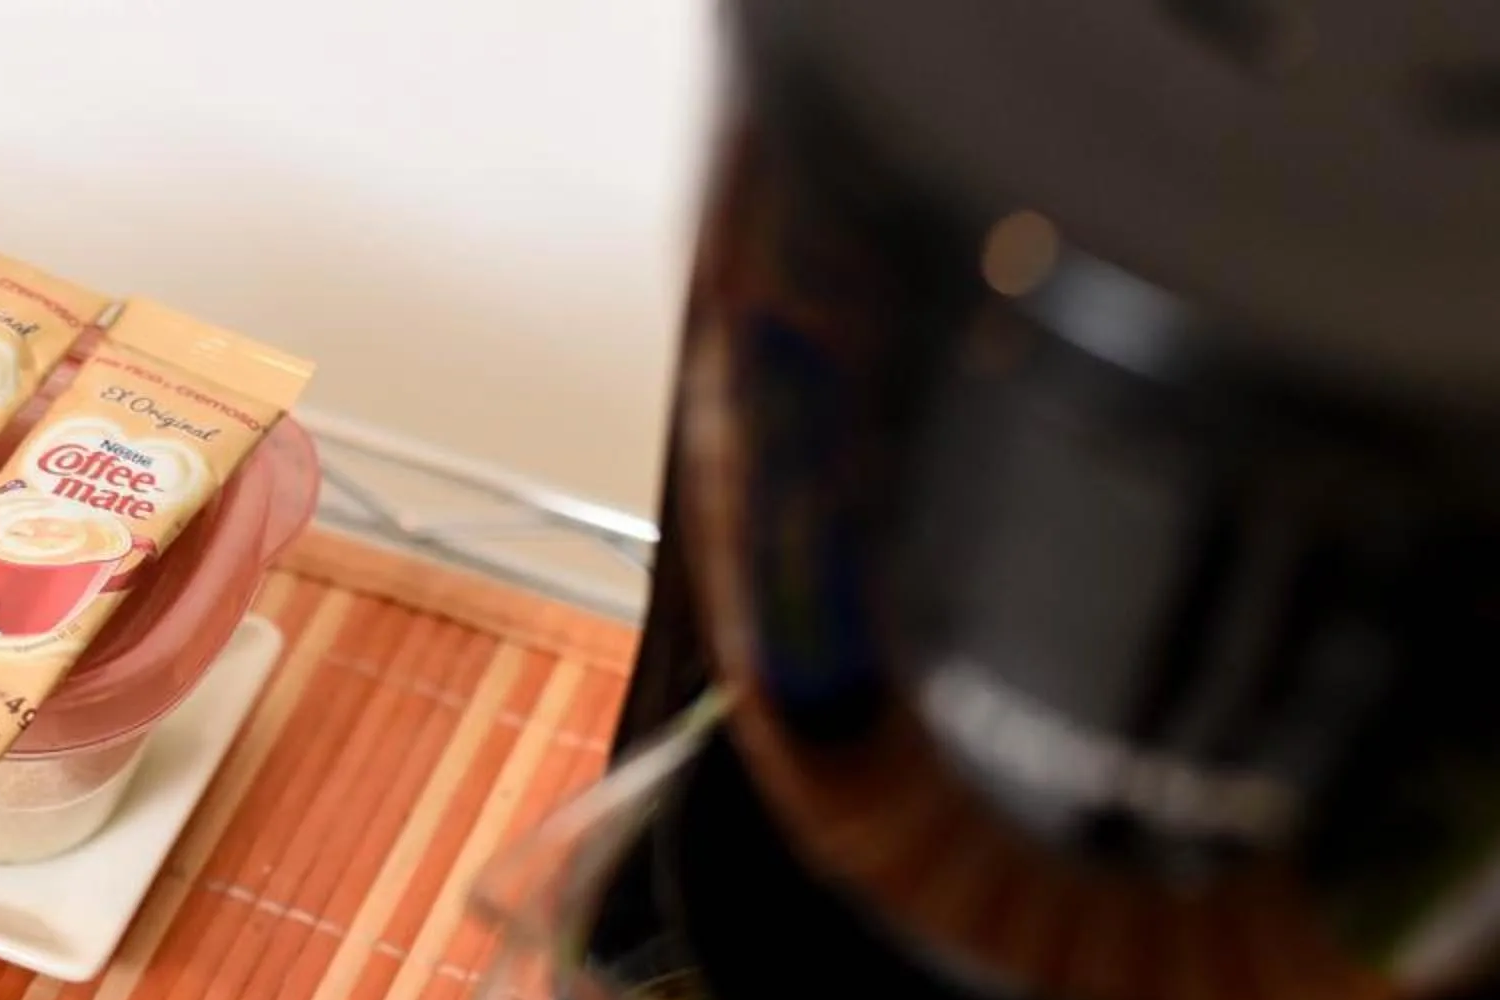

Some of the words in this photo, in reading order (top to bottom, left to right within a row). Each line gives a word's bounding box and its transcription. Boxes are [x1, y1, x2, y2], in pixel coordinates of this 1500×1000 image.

[100, 386, 132, 402] El
[129, 397, 221, 442] Original
[51, 476, 156, 521] mate
[5, 697, 27, 714] 4
